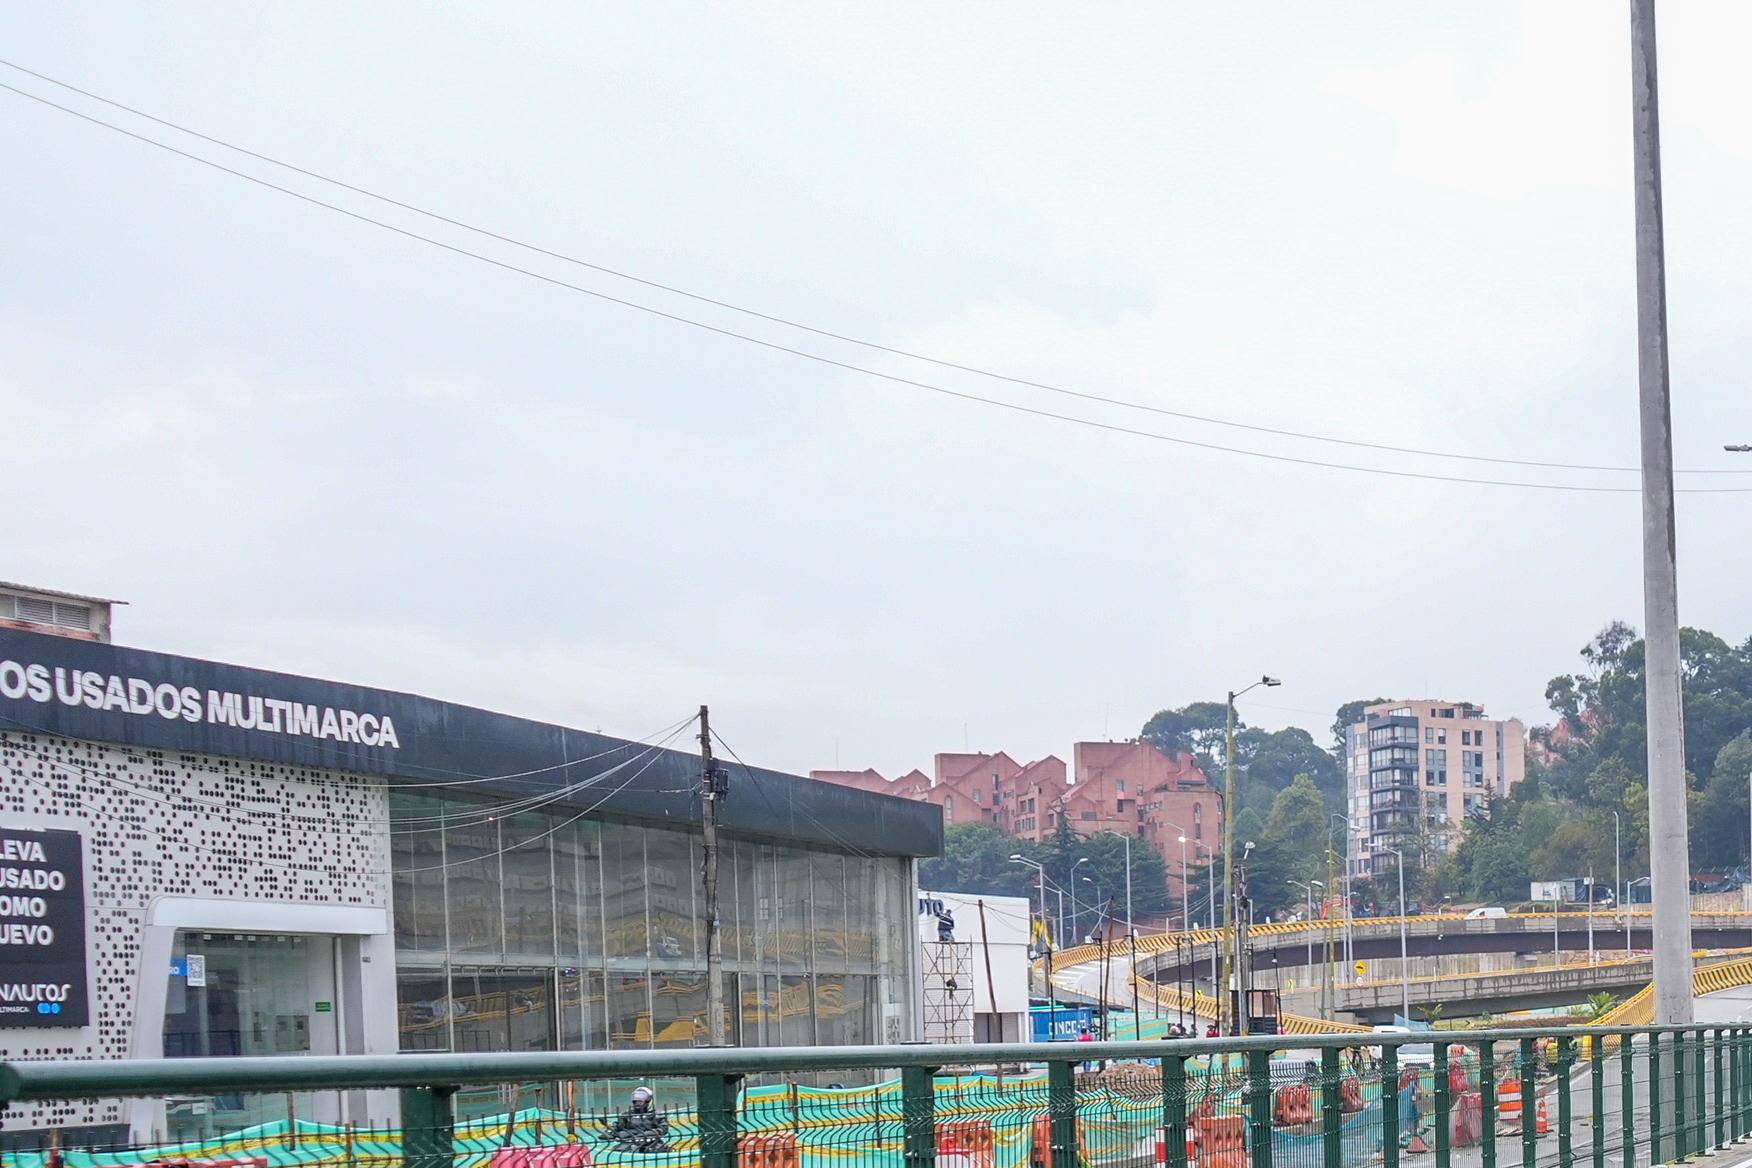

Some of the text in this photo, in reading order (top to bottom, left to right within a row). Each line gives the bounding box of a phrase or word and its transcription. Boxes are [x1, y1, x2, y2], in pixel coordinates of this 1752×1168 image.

[0, 660, 400, 749] OS USADOS MULTIMARCA
